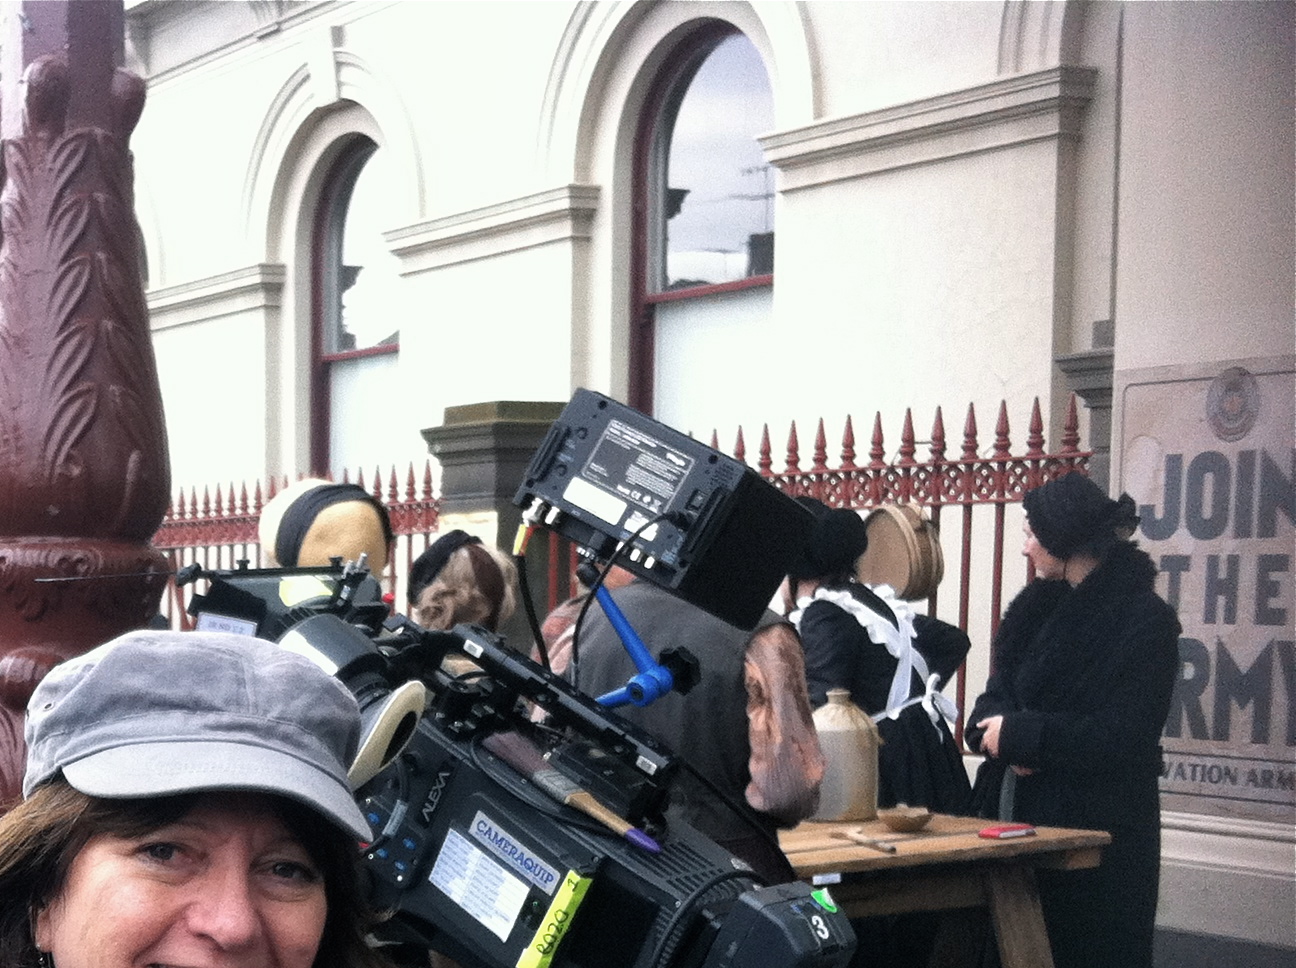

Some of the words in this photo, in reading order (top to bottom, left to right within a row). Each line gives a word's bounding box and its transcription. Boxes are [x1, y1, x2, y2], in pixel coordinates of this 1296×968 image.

[1139, 447, 1296, 541] JOIN
[1158, 553, 1290, 626] THE
[1165, 635, 1296, 747] RM
[421, 772, 451, 823] ALEXA
[475, 818, 556, 885] CAMERAQUIP
[811, 915, 830, 940] 3
